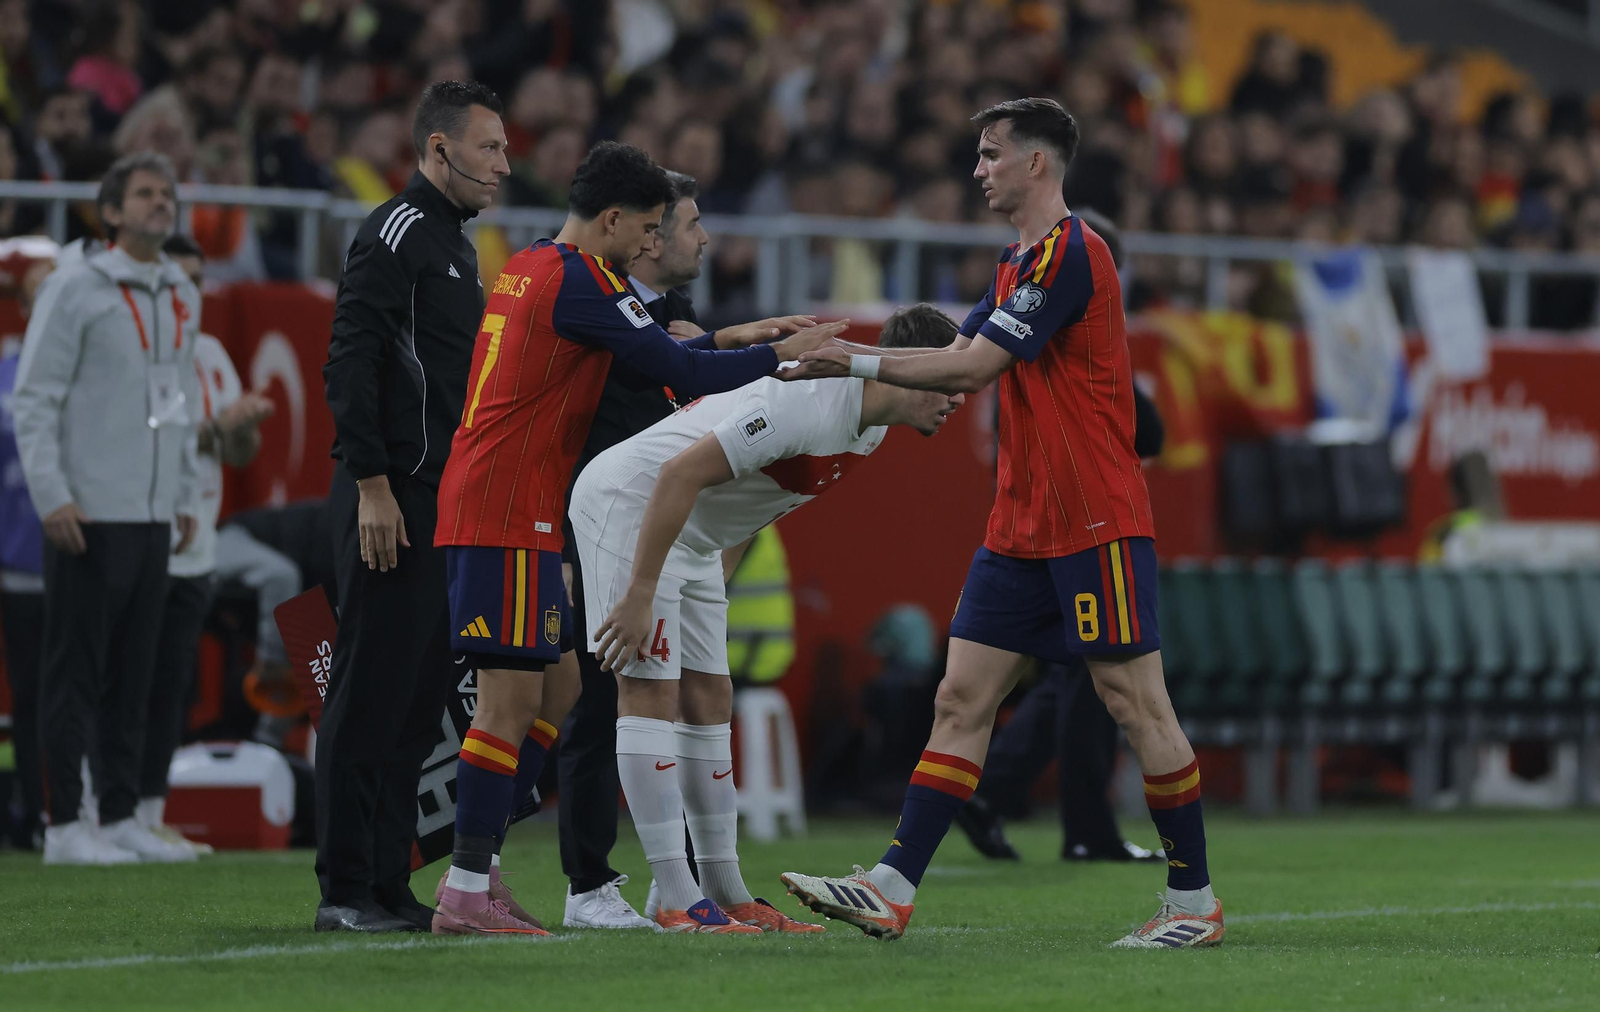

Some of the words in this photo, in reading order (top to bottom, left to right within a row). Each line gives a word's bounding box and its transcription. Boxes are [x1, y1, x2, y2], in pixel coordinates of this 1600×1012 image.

[461, 313, 507, 428] 7
[637, 618, 671, 663] 4
[1074, 592, 1100, 642] 8
[308, 658, 328, 703] EAN
